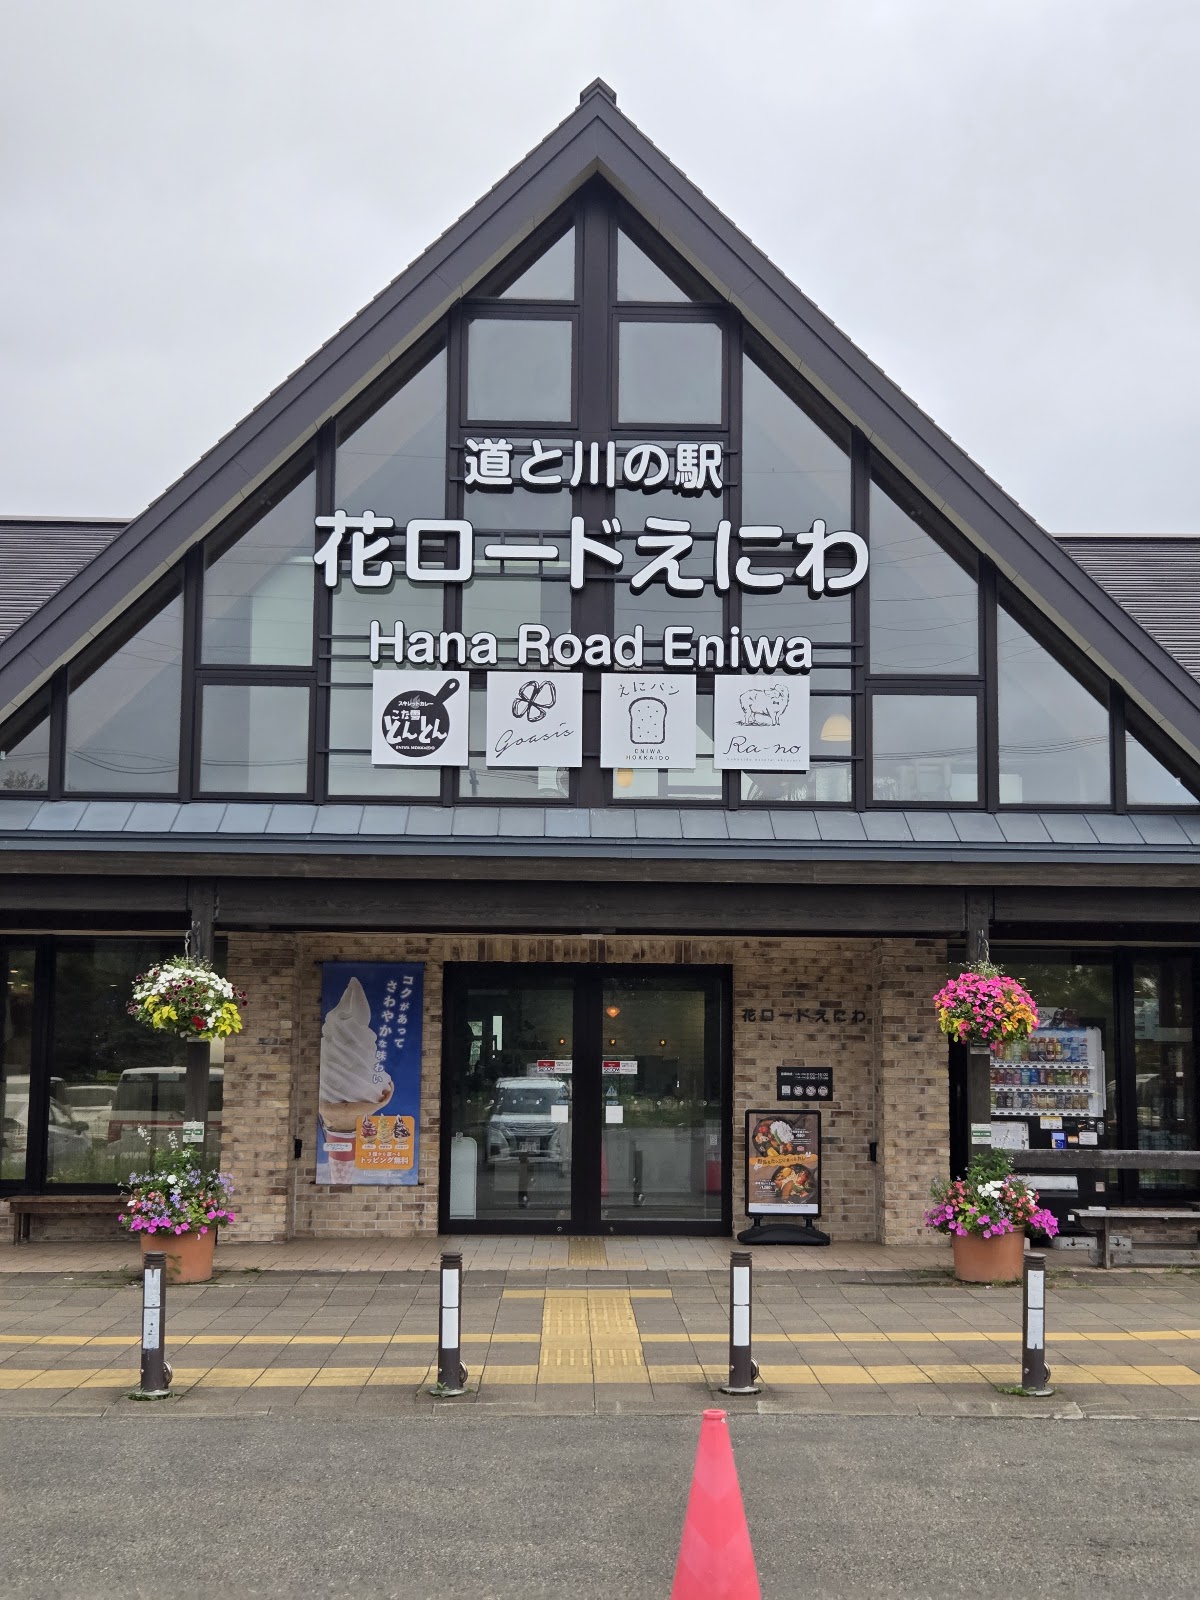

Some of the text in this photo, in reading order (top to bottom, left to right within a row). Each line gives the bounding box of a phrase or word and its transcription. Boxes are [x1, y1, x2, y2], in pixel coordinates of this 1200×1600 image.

[464, 437, 724, 492] 道と川の駅
[313, 508, 870, 594] 花ロードえにわ
[369, 620, 813, 670] Hana Road Eniwa
[617, 681, 680, 698] えにパン
[371, 979, 399, 1085] さわやかな味わい
[394, 974, 414, 1049] コクがあって
[741, 1007, 866, 1023] 花ロードえにわ
[360, 1156, 409, 1165] トッピング無料
